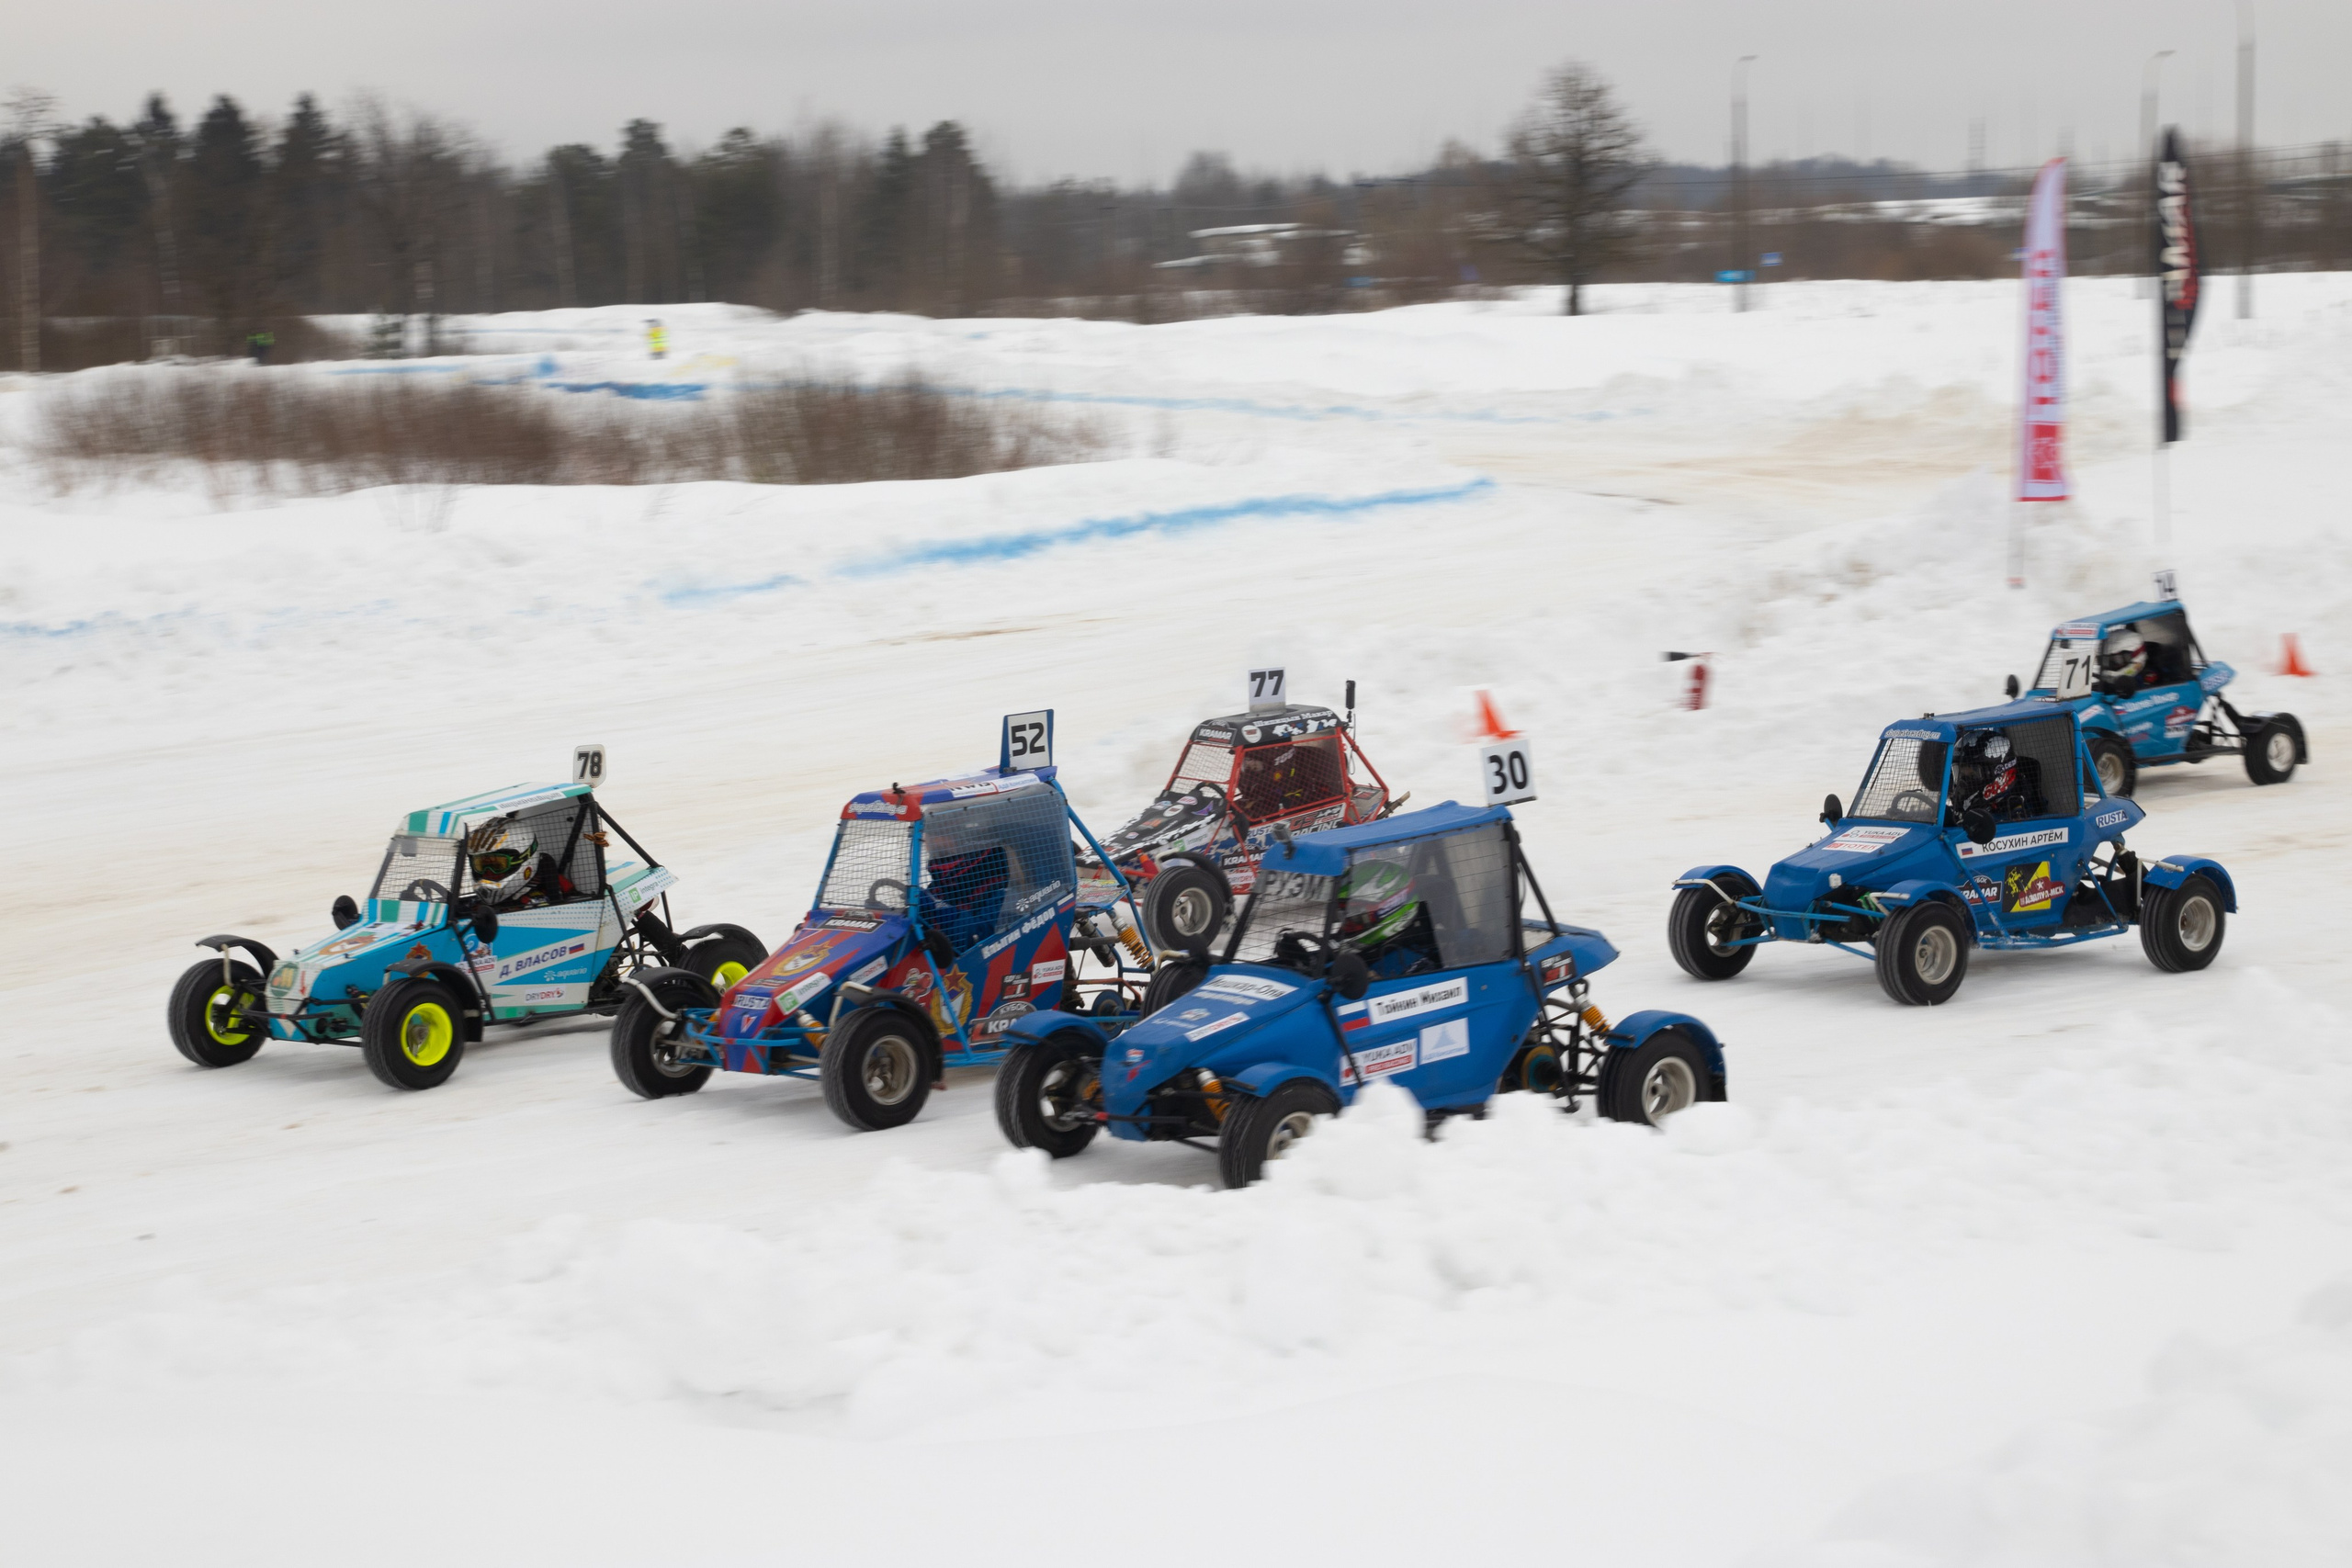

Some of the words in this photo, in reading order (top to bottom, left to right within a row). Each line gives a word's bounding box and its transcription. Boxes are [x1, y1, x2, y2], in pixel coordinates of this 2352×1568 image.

[1250, 670, 1283, 697] 77
[2066, 655, 2091, 689] 71
[1011, 722, 1046, 757] 52
[1199, 728, 1232, 740] KRAMAR
[577, 750, 603, 780] 78
[1487, 750, 1529, 795] 30
[2098, 809, 2128, 827] RUSTA
[1982, 835, 2029, 853] КОСУХИН
[2030, 829, 2063, 846] АРТЁМ
[1029, 880, 1061, 902] aquario
[826, 918, 877, 931] KRAMAR
[514, 945, 567, 972] ВЛАСОВ
[556, 967, 587, 979] aquario
[526, 988, 555, 1001] DRYDRY
[735, 994, 771, 1010] RUSTA
